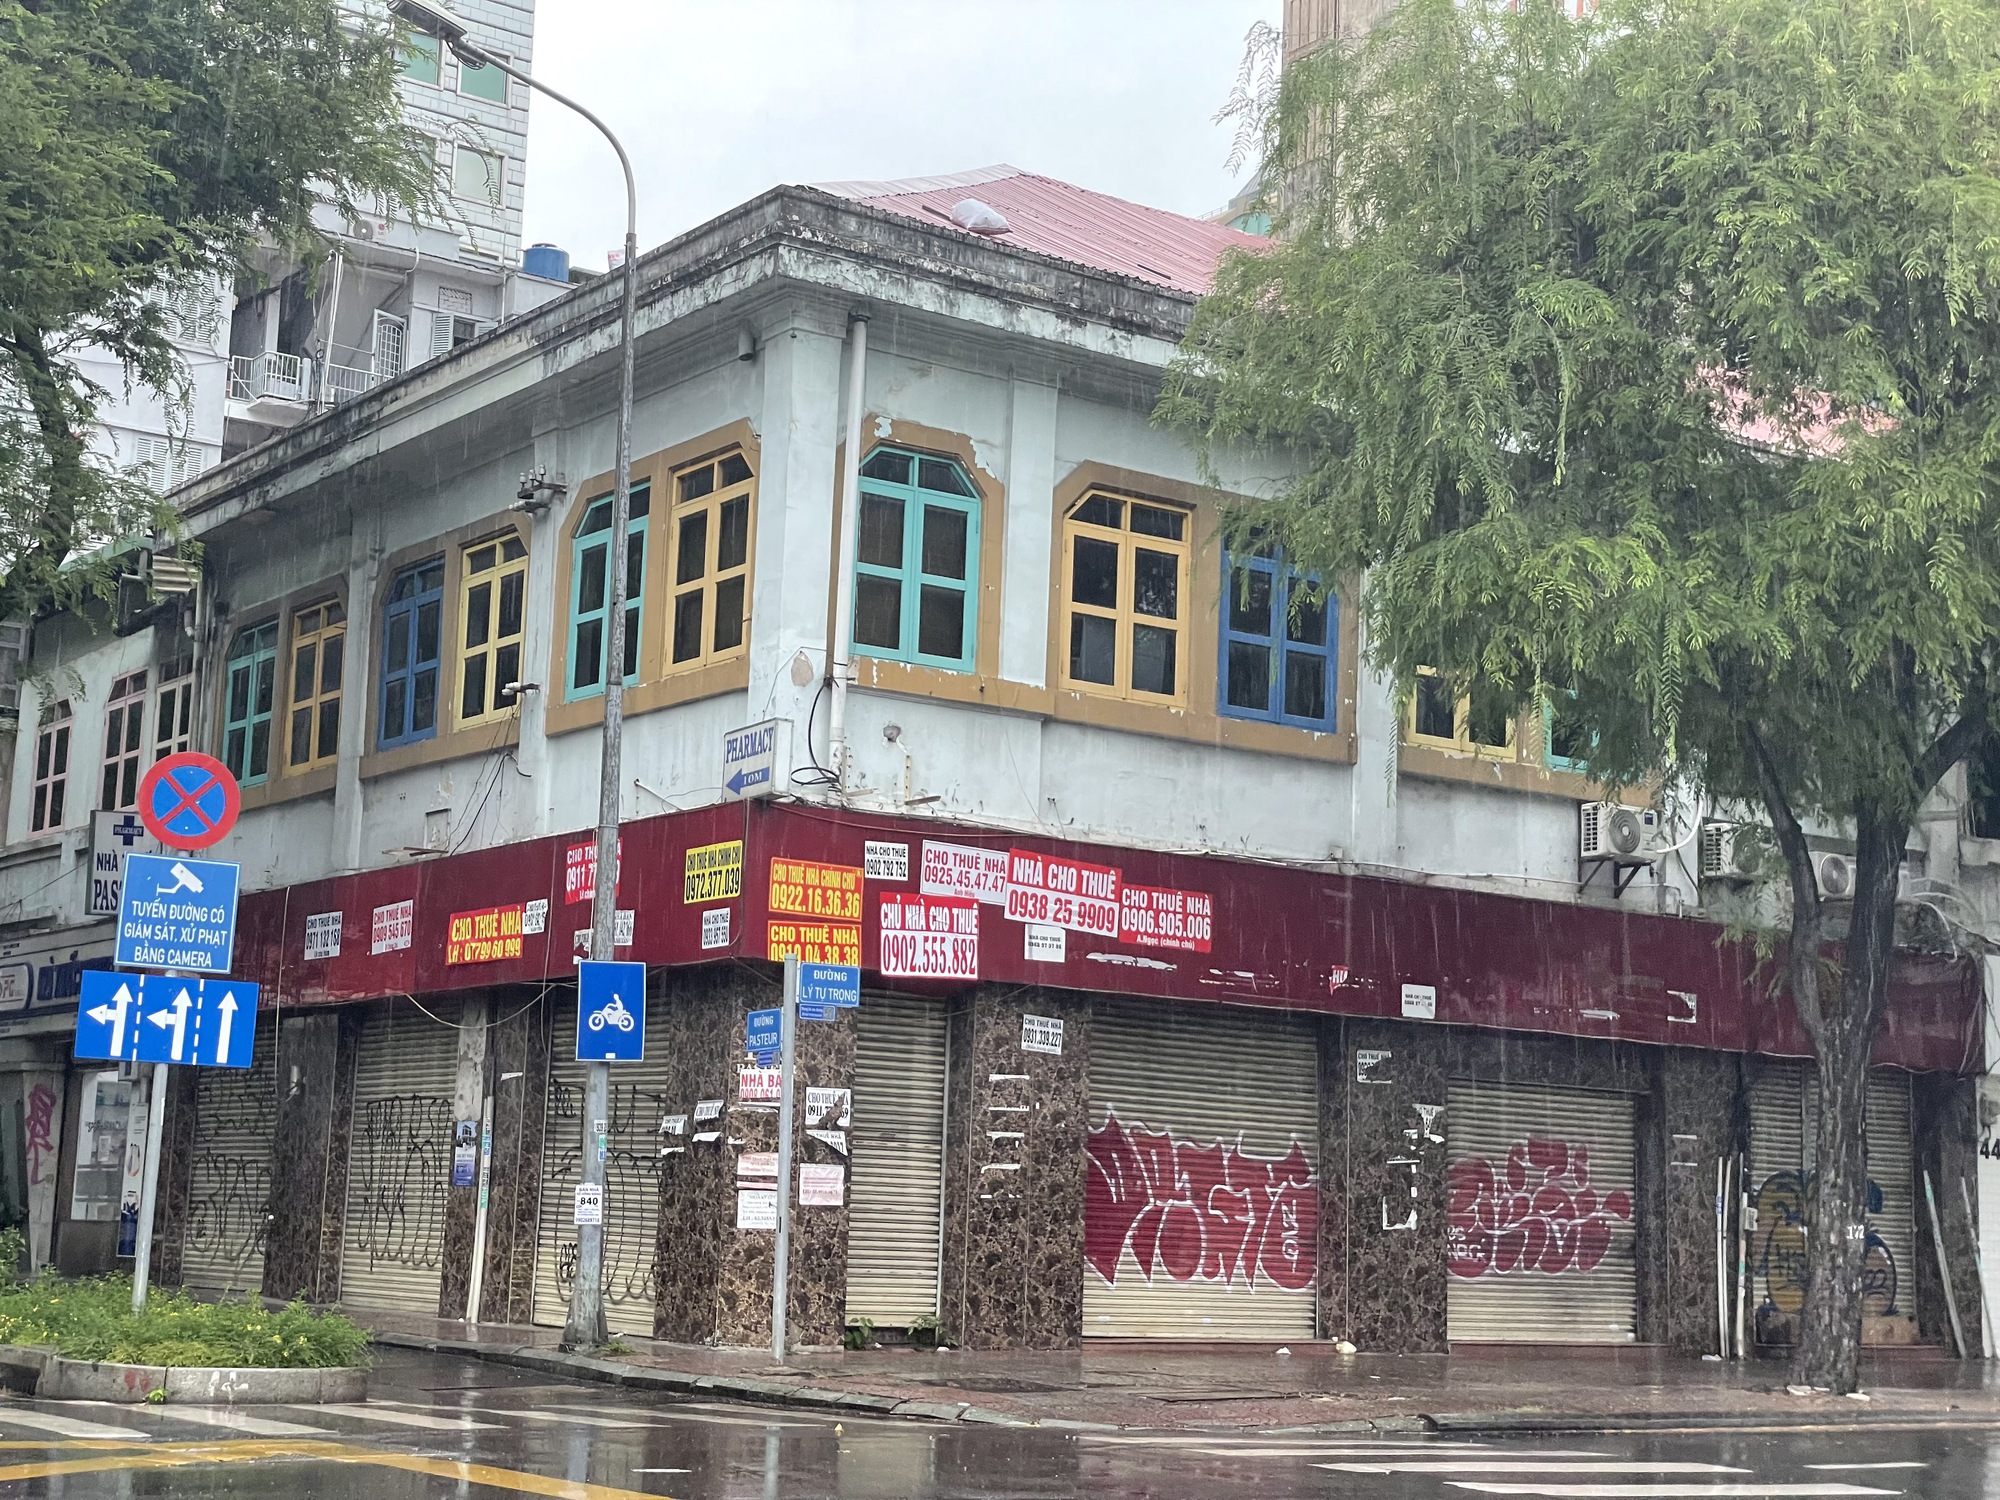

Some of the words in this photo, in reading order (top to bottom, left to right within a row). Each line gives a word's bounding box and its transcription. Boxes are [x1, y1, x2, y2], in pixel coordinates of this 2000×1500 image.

[726, 726, 774, 764] PHARMACY
[743, 771, 762, 785] 10M
[97, 849, 118, 872] NHÀ
[567, 848, 582, 864] CHO
[866, 845, 878, 856] NHÀ
[880, 846, 891, 857] CHO
[892, 846, 906, 858] THUÊ
[925, 848, 949, 866] CHO
[952, 852, 981, 870] THUÊ
[985, 856, 1006, 874] NHÀ
[566, 864, 585, 892] 0911
[773, 863, 787, 882] CHO
[788, 863, 804, 884] THUÊ
[806, 865, 819, 886] NHÀ
[866, 859, 881, 875] 0902
[882, 860, 894, 877] 792
[895, 861, 907, 878] 752
[924, 865, 1006, 893] 0925.45.47.47
[1012, 855, 1043, 886] NHÀ
[1047, 863, 1077, 892] CHO
[1081, 869, 1116, 900] THUÊ
[686, 866, 740, 901] 0972.377.039
[132, 898, 167, 919] TUYẾN
[169, 902, 208, 923] ĐƯỜNG
[210, 905, 225, 924] CÓ
[772, 883, 860, 918] 0922.16.36.36
[1009, 889, 1048, 920] 0938
[1052, 897, 1073, 925] 25
[1077, 901, 1116, 933] 9909
[1122, 888, 1148, 908] CHO
[1151, 891, 1183, 912] THUÊ
[1186, 894, 1211, 916] NHÀ
[307, 918, 318, 929] CHO
[373, 911, 384, 925] CHO
[386, 905, 399, 923] THUÊ
[451, 917, 472, 942] CHO
[474, 908, 498, 939] THUÊ
[501, 906, 521, 936] NHÀ
[881, 894, 901, 929] CHỦ
[905, 899, 926, 930] NHÀ
[929, 906, 950, 932] CHO
[951, 902, 978, 935] THUÊ
[1121, 907, 1211, 940] 0906.905.006
[124, 919, 153, 940] GIÁM
[180, 923, 197, 943] XỬ
[198, 929, 228, 949] PHẠT
[771, 925, 796, 942] CHO
[799, 925, 829, 944] THUÊ
[833, 926, 858, 945] NHÀ
[134, 940, 165, 964] BẰNG
[167, 948, 212, 968] CAMERA
[505, 938, 521, 957] 999
[883, 934, 976, 975] 0902.555.882
[814, 969, 847, 981] ĐƯỜNG
[802, 984, 813, 998] LÝ
[815, 987, 827, 1002] TỰ
[828, 987, 857, 1003] TRỌNG
[753, 1015, 774, 1027] ĐƯỜNG
[1025, 1017, 1035, 1026] CHO
[1036, 1018, 1050, 1028] THUÊ
[749, 1032, 778, 1047] PASTEUR
[1023, 1027, 1062, 1048] 0931.339.227
[741, 1070, 763, 1087] NHÀ
[768, 1070, 782, 1087] BÁ
[808, 1092, 821, 1104] CHO
[580, 1197, 598, 1206] 840
